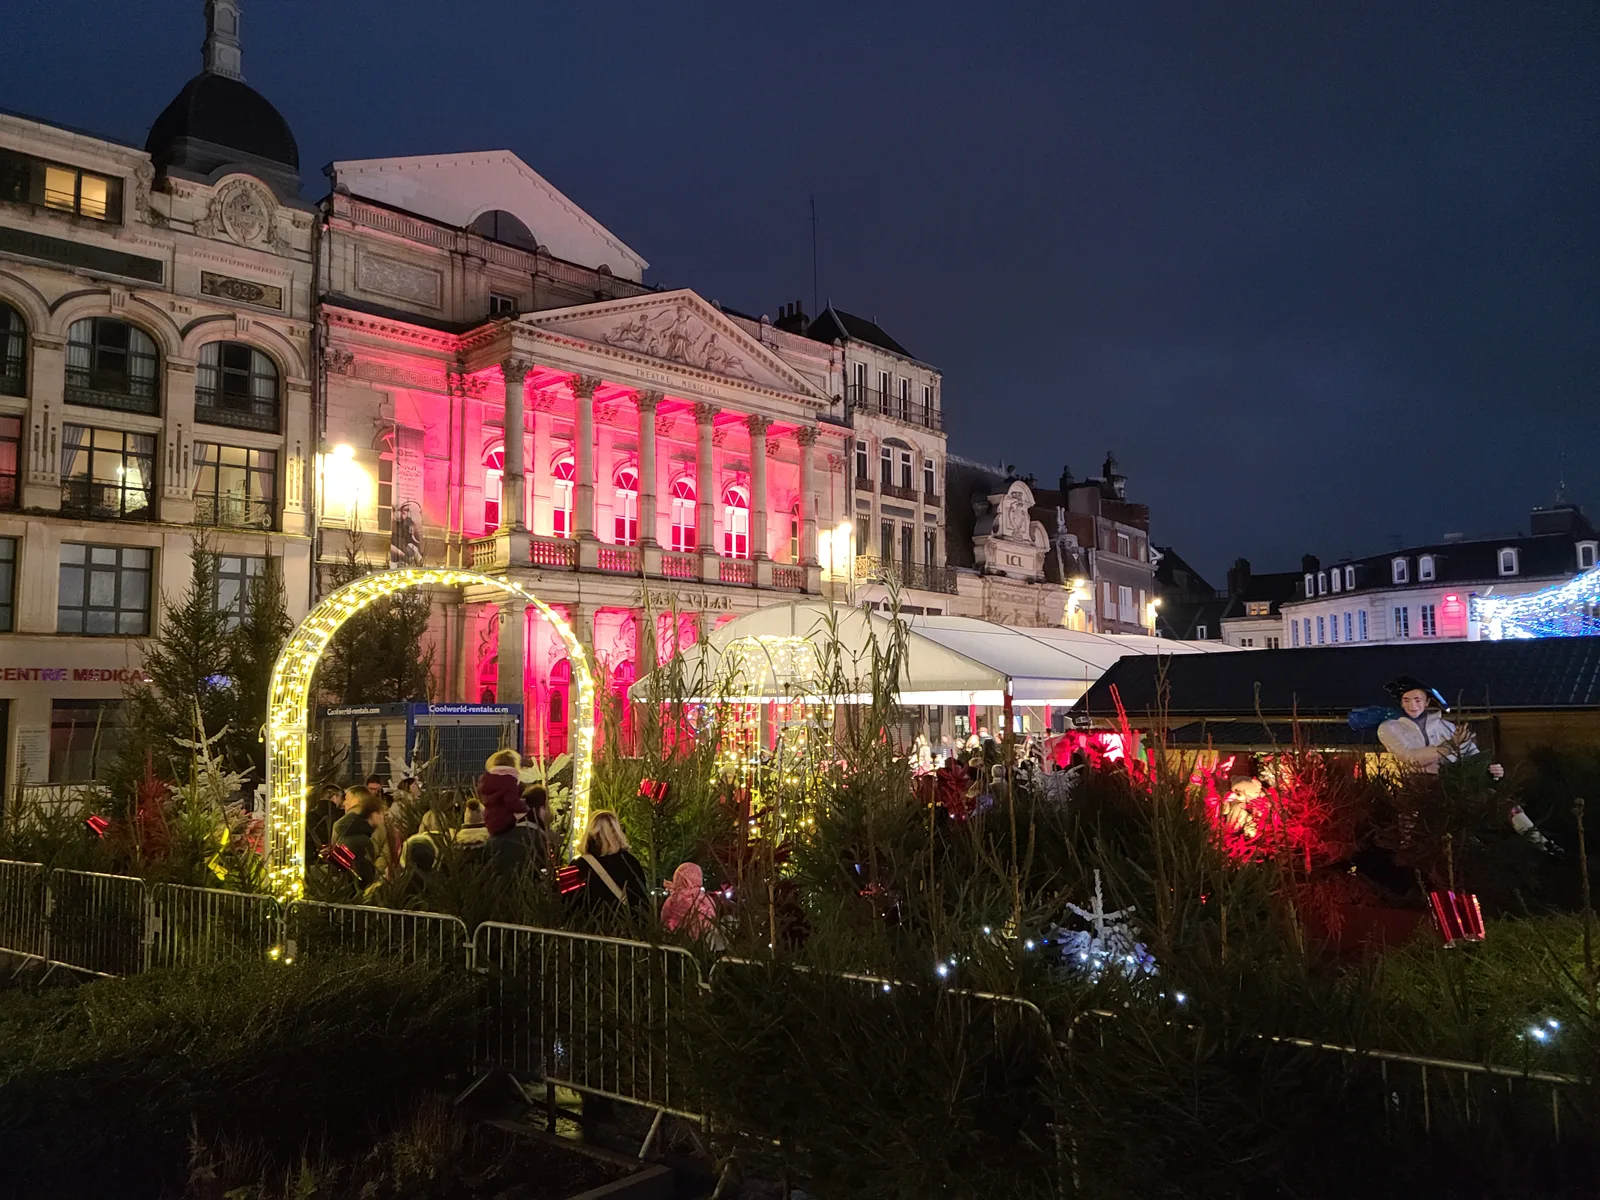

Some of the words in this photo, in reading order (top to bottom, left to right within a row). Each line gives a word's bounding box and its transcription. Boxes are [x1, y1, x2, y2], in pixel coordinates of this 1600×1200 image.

[227, 283, 257, 300] 1923
[636, 368, 671, 384] THEATRE
[681, 380, 721, 396] MUNICIPAL
[1006, 554, 1024, 568] LCL
[688, 594, 733, 610] VILAR
[0, 668, 67, 682] ENTRE
[428, 704, 509, 714] Coolworld-rentals.com
